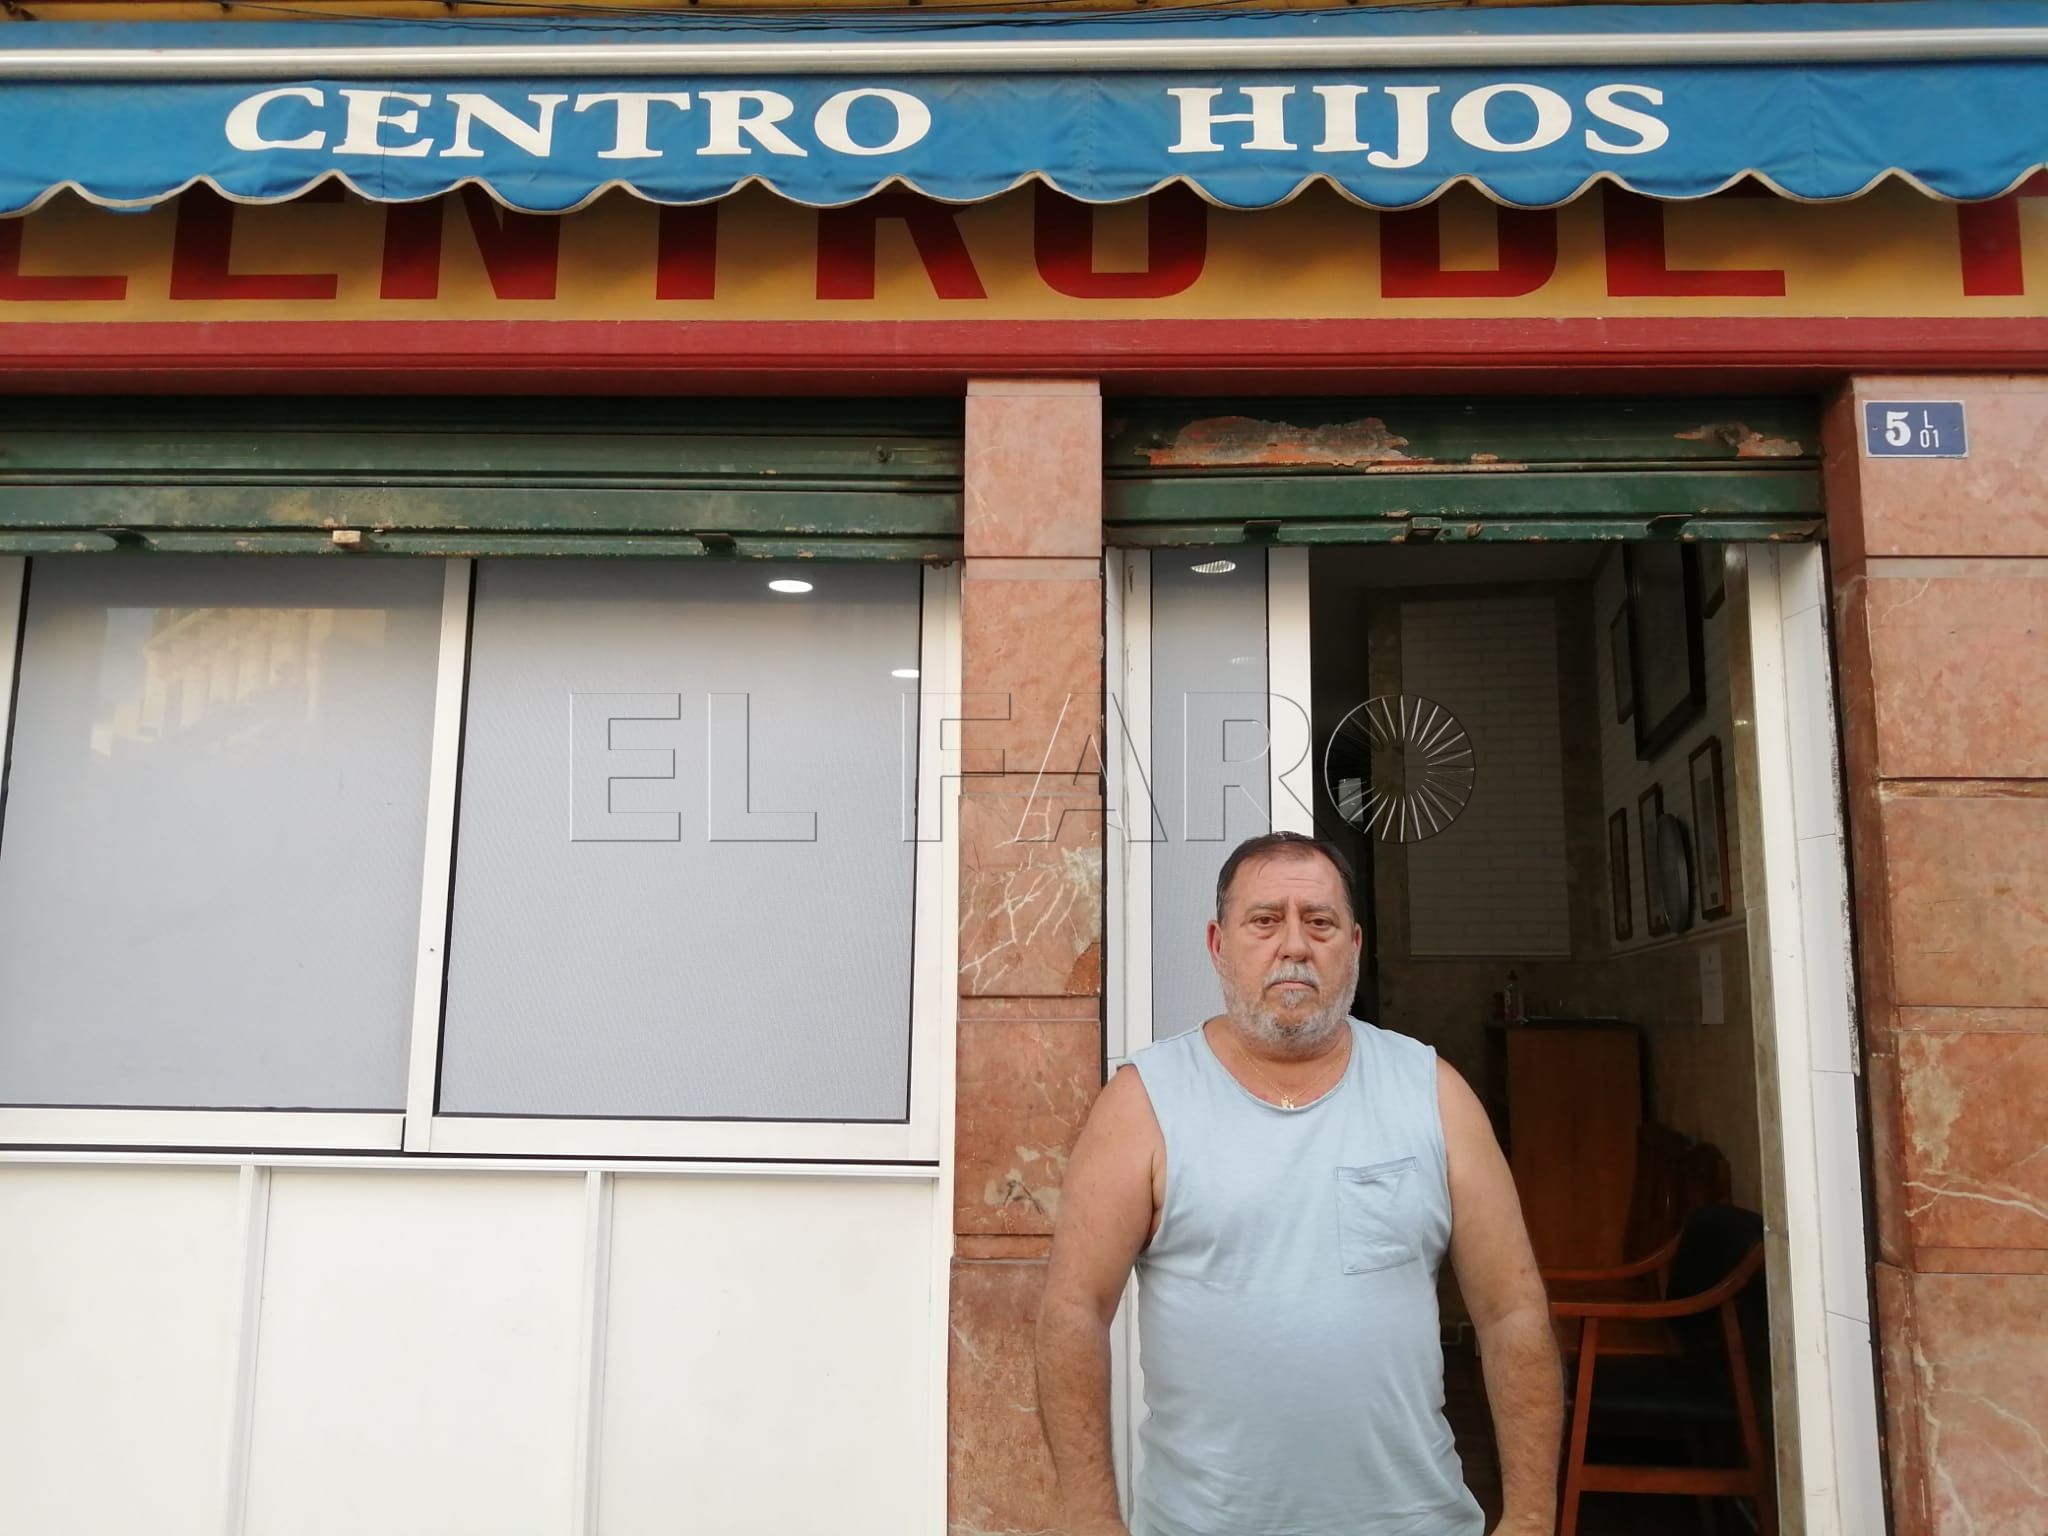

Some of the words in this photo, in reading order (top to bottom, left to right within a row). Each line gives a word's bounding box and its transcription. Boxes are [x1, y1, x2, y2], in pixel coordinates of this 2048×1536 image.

[224, 87, 932, 159] CENTRO
[1166, 83, 1670, 168] HIJOS
[1885, 410, 1911, 447] 5
